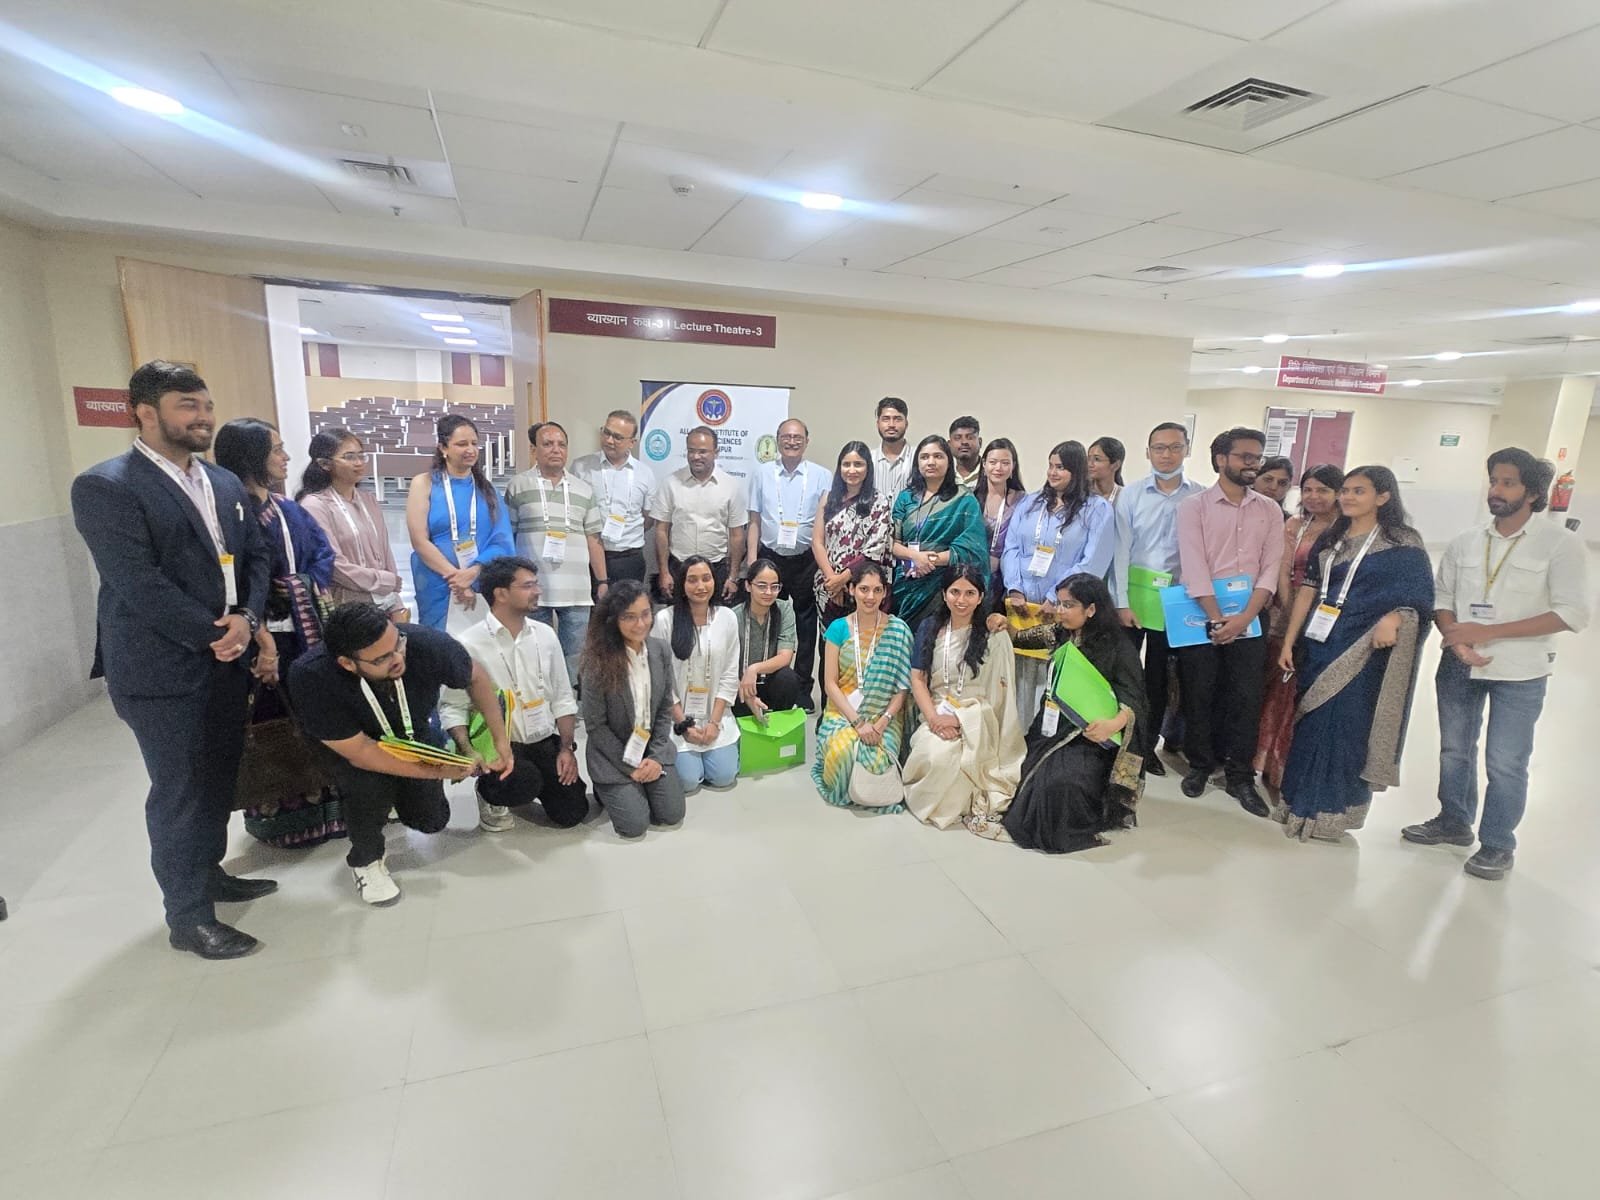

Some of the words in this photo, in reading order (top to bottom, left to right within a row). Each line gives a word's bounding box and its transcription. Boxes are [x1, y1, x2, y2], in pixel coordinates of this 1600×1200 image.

[586, 313, 628, 326] व्याख्यान
[673, 321, 712, 332] Lecture
[713, 323, 763, 336] Theatre-3
[84, 400, 127, 413] व्याख्यान
[717, 437, 742, 445] CIENCES
